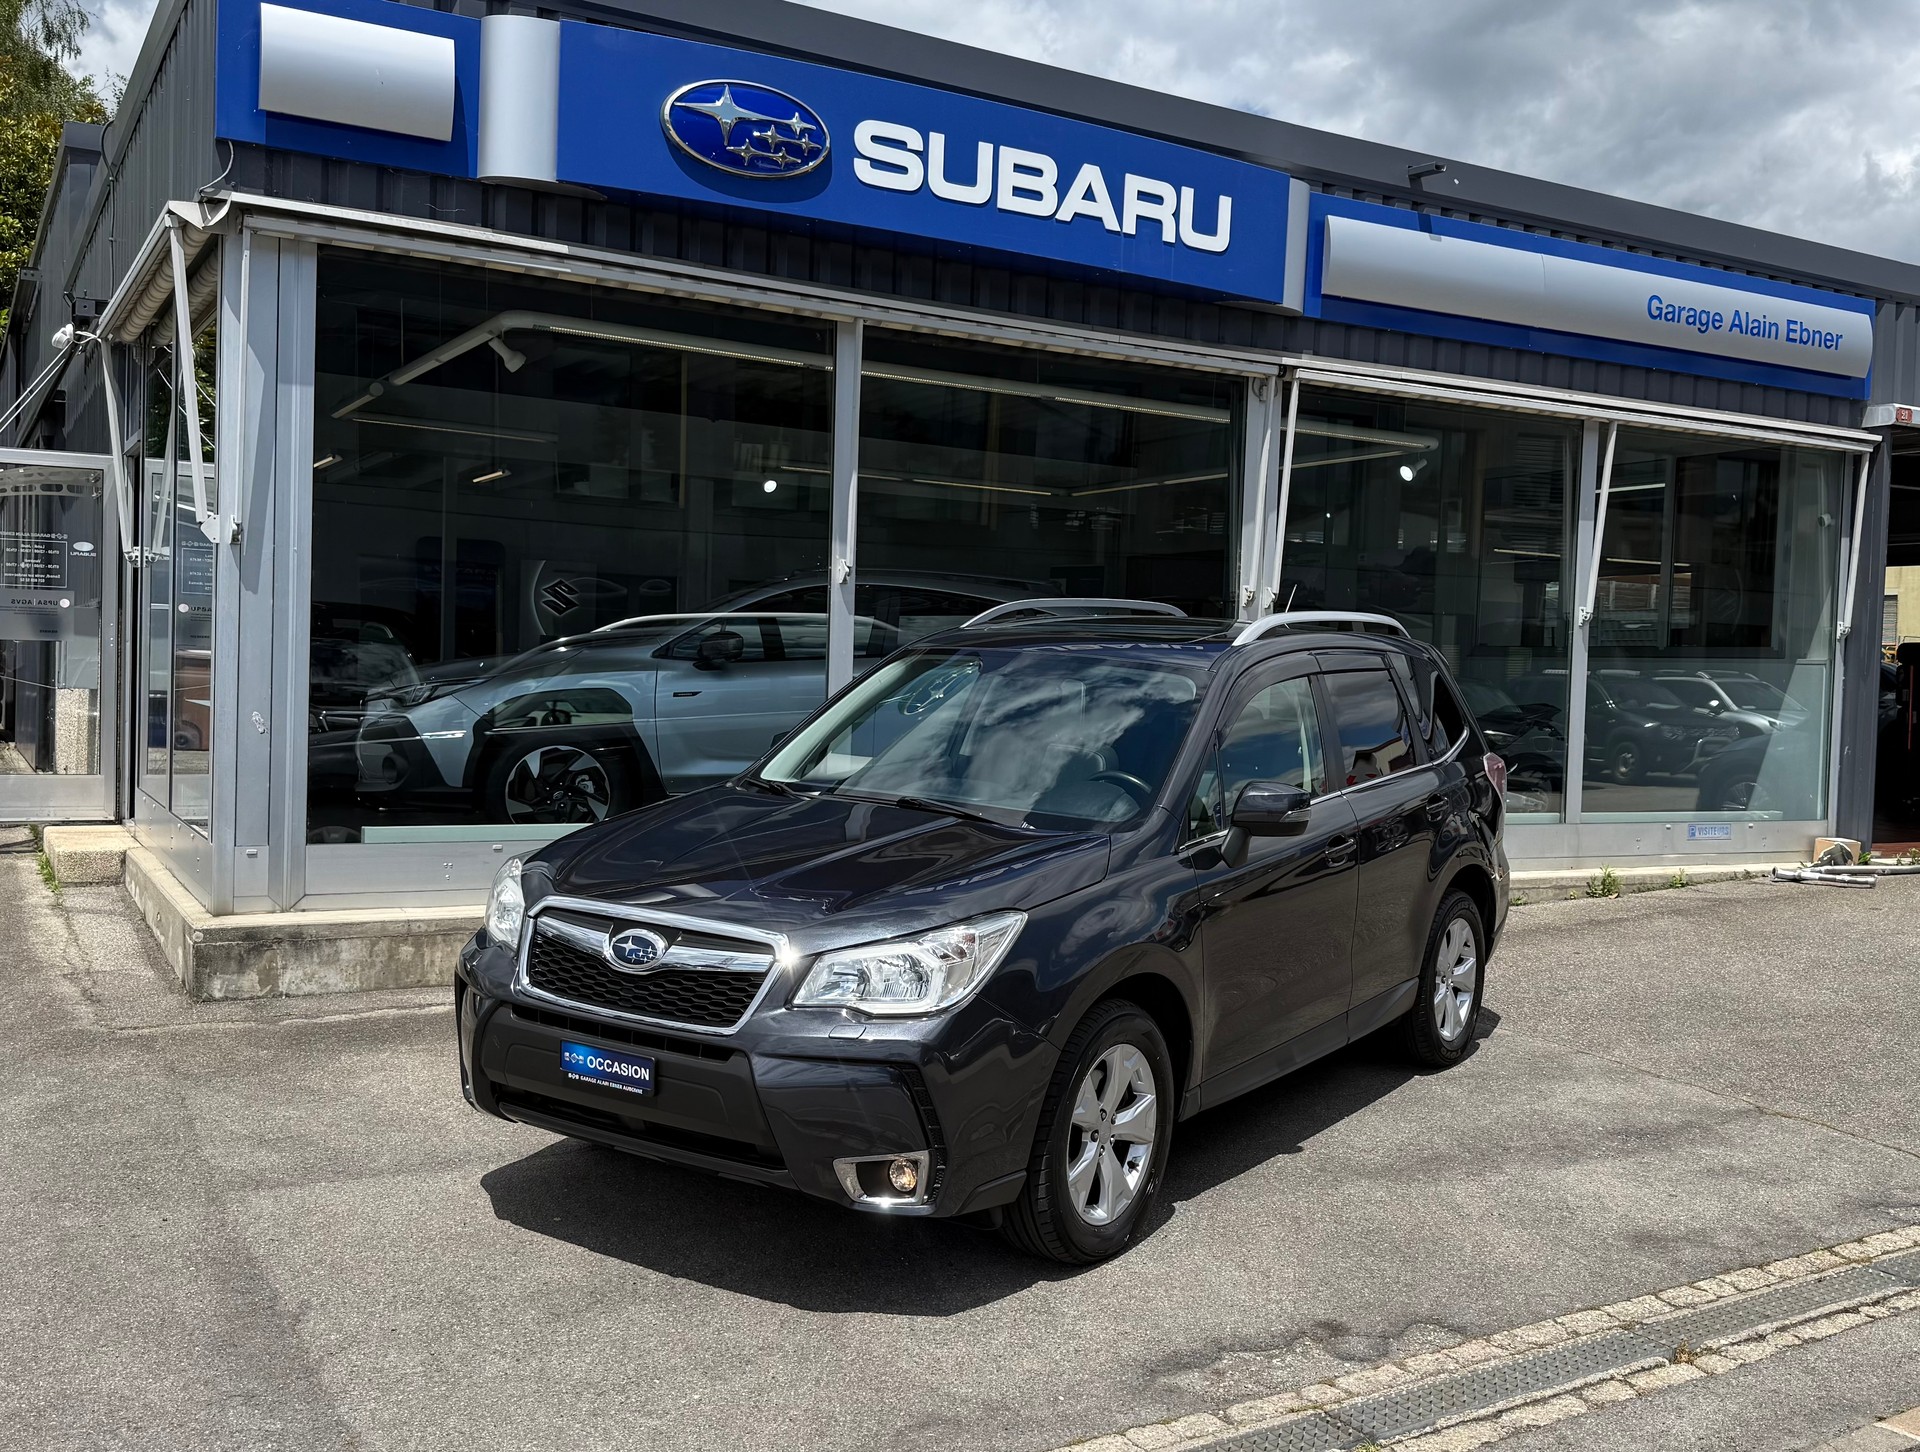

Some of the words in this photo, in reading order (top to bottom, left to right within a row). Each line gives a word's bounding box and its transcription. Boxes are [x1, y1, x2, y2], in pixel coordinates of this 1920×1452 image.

[853, 119, 1232, 253] SUBARU
[1647, 295, 1724, 334] Garage
[1728, 309, 1780, 341] Alain
[1785, 319, 1844, 351] Ebner
[580, 1076, 597, 1084] GARAGE
[597, 1079, 610, 1087] ALAIN
[587, 1056, 649, 1080] OCCASION
